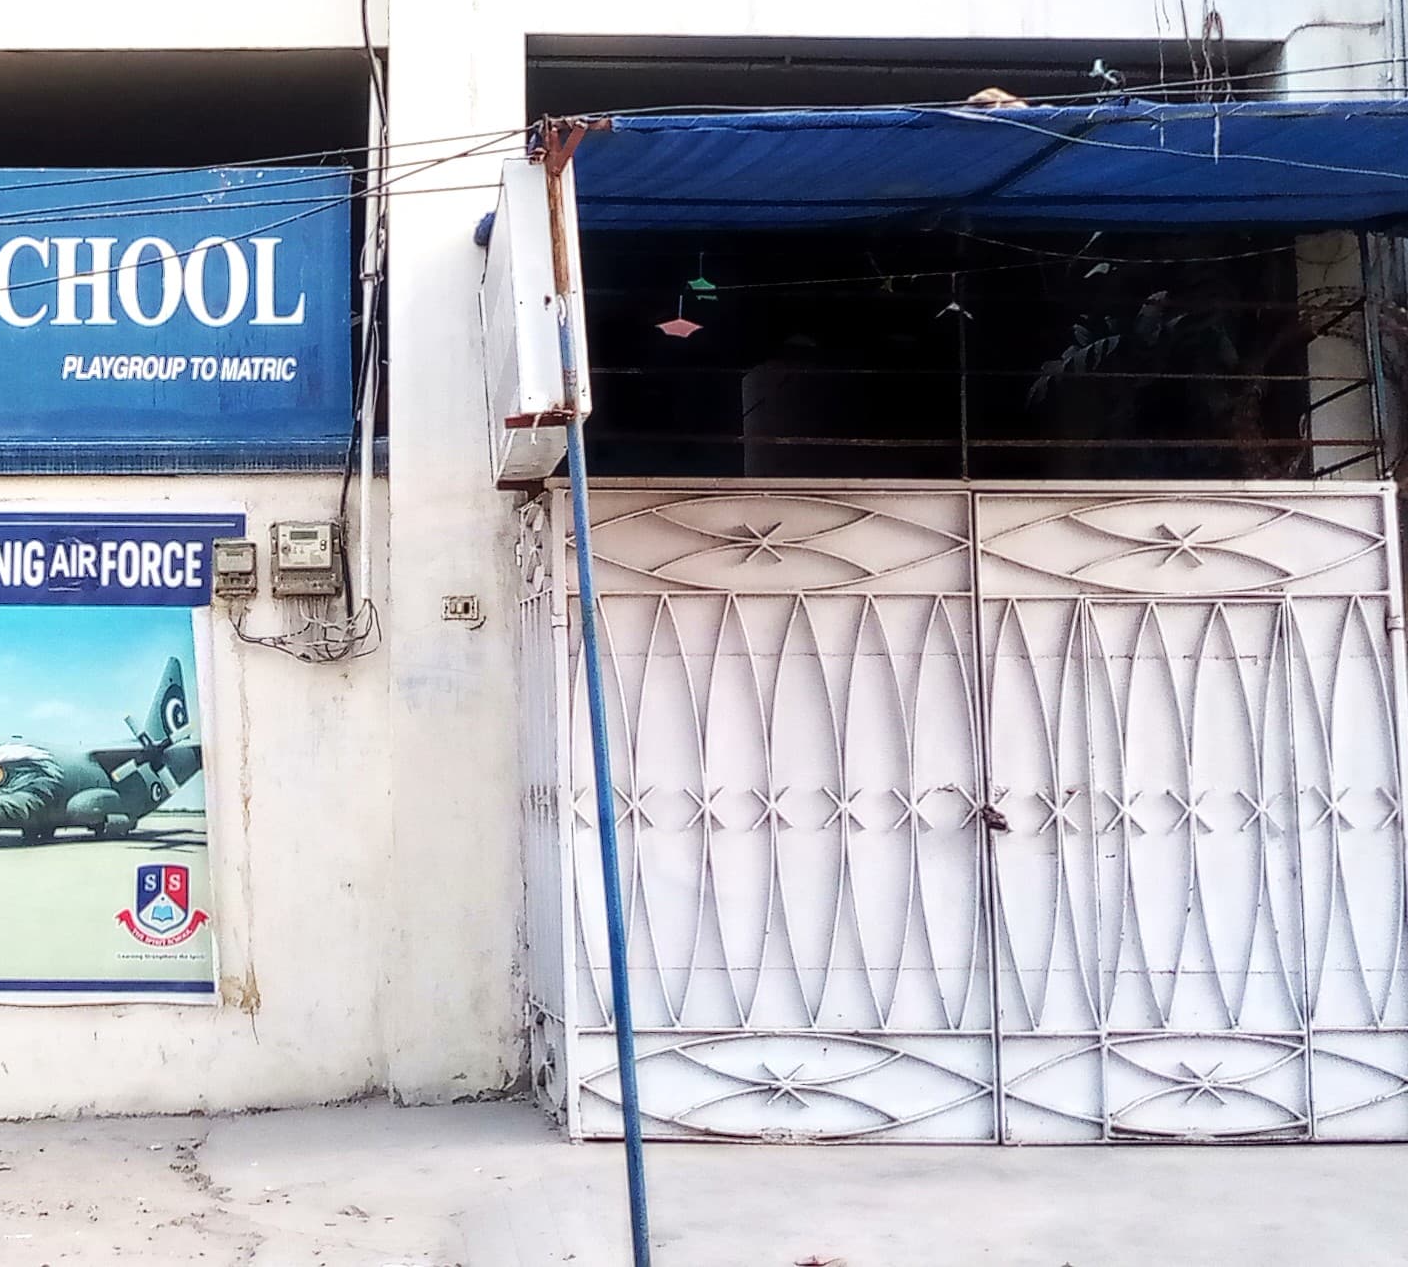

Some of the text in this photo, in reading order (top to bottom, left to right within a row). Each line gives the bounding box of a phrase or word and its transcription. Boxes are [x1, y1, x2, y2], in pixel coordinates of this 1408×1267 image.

[62, 355, 297, 381] PLAYGROUP TO MATRIC
[49, 542, 98, 580] AIR
[100, 541, 204, 588] FORCE
